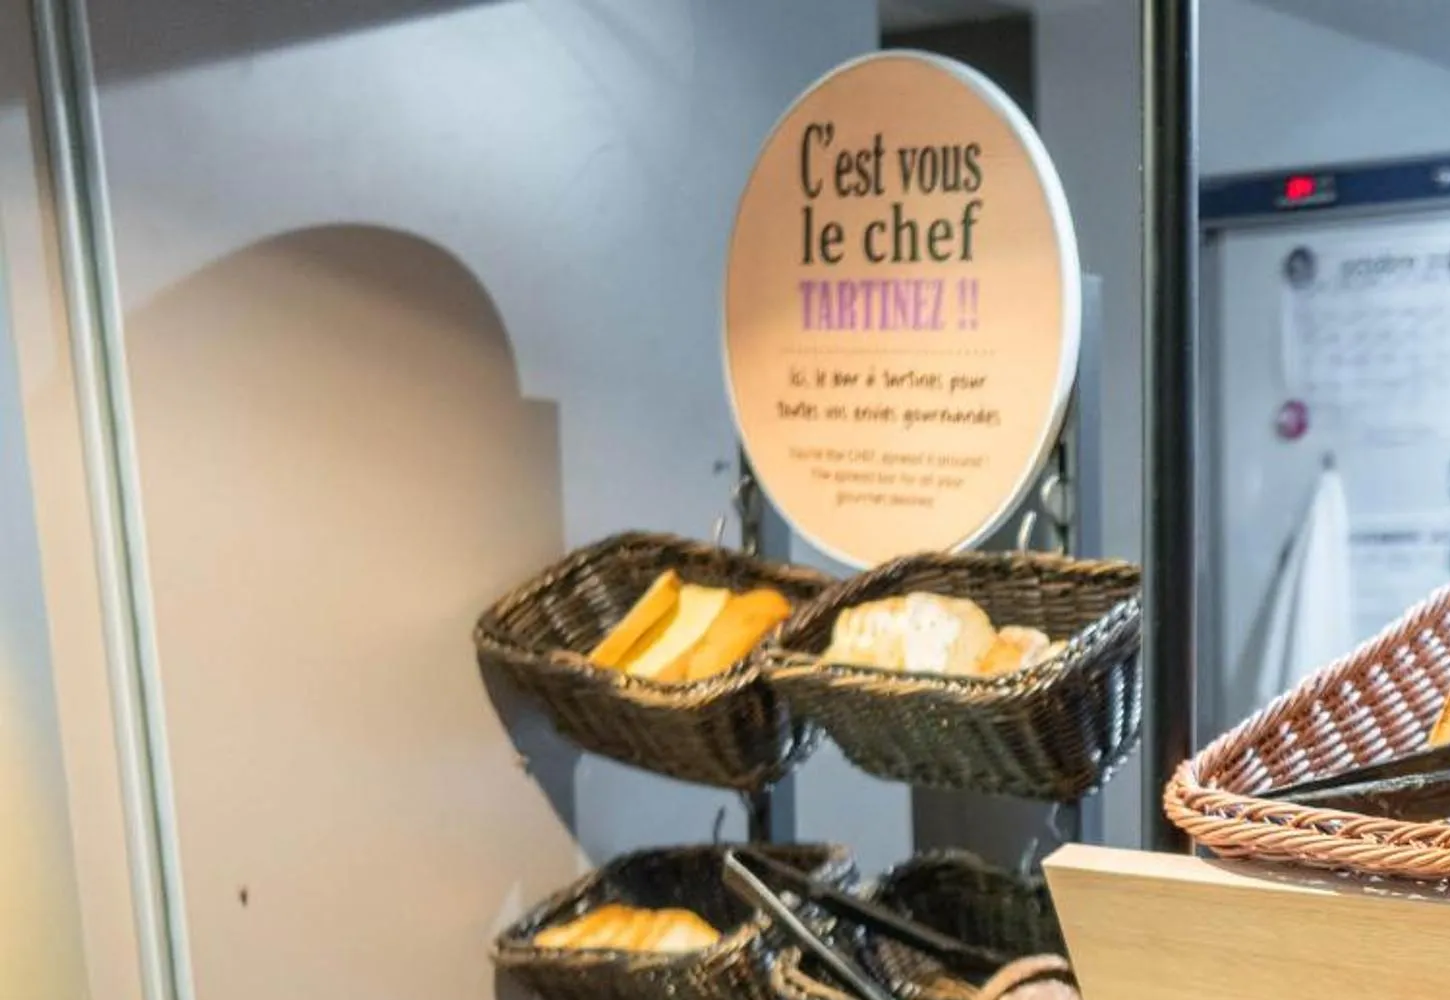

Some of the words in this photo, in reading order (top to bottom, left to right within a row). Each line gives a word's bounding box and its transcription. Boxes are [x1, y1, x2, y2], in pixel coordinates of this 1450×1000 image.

[800, 122, 885, 199] C'est
[897, 142, 982, 194] vous
[801, 205, 845, 265] le
[864, 200, 983, 263] chef
[799, 278, 945, 331] TARTINEZ
[958, 278, 979, 331] !!
[950, 372, 987, 395] pour
[902, 407, 1001, 430] gourmandes
